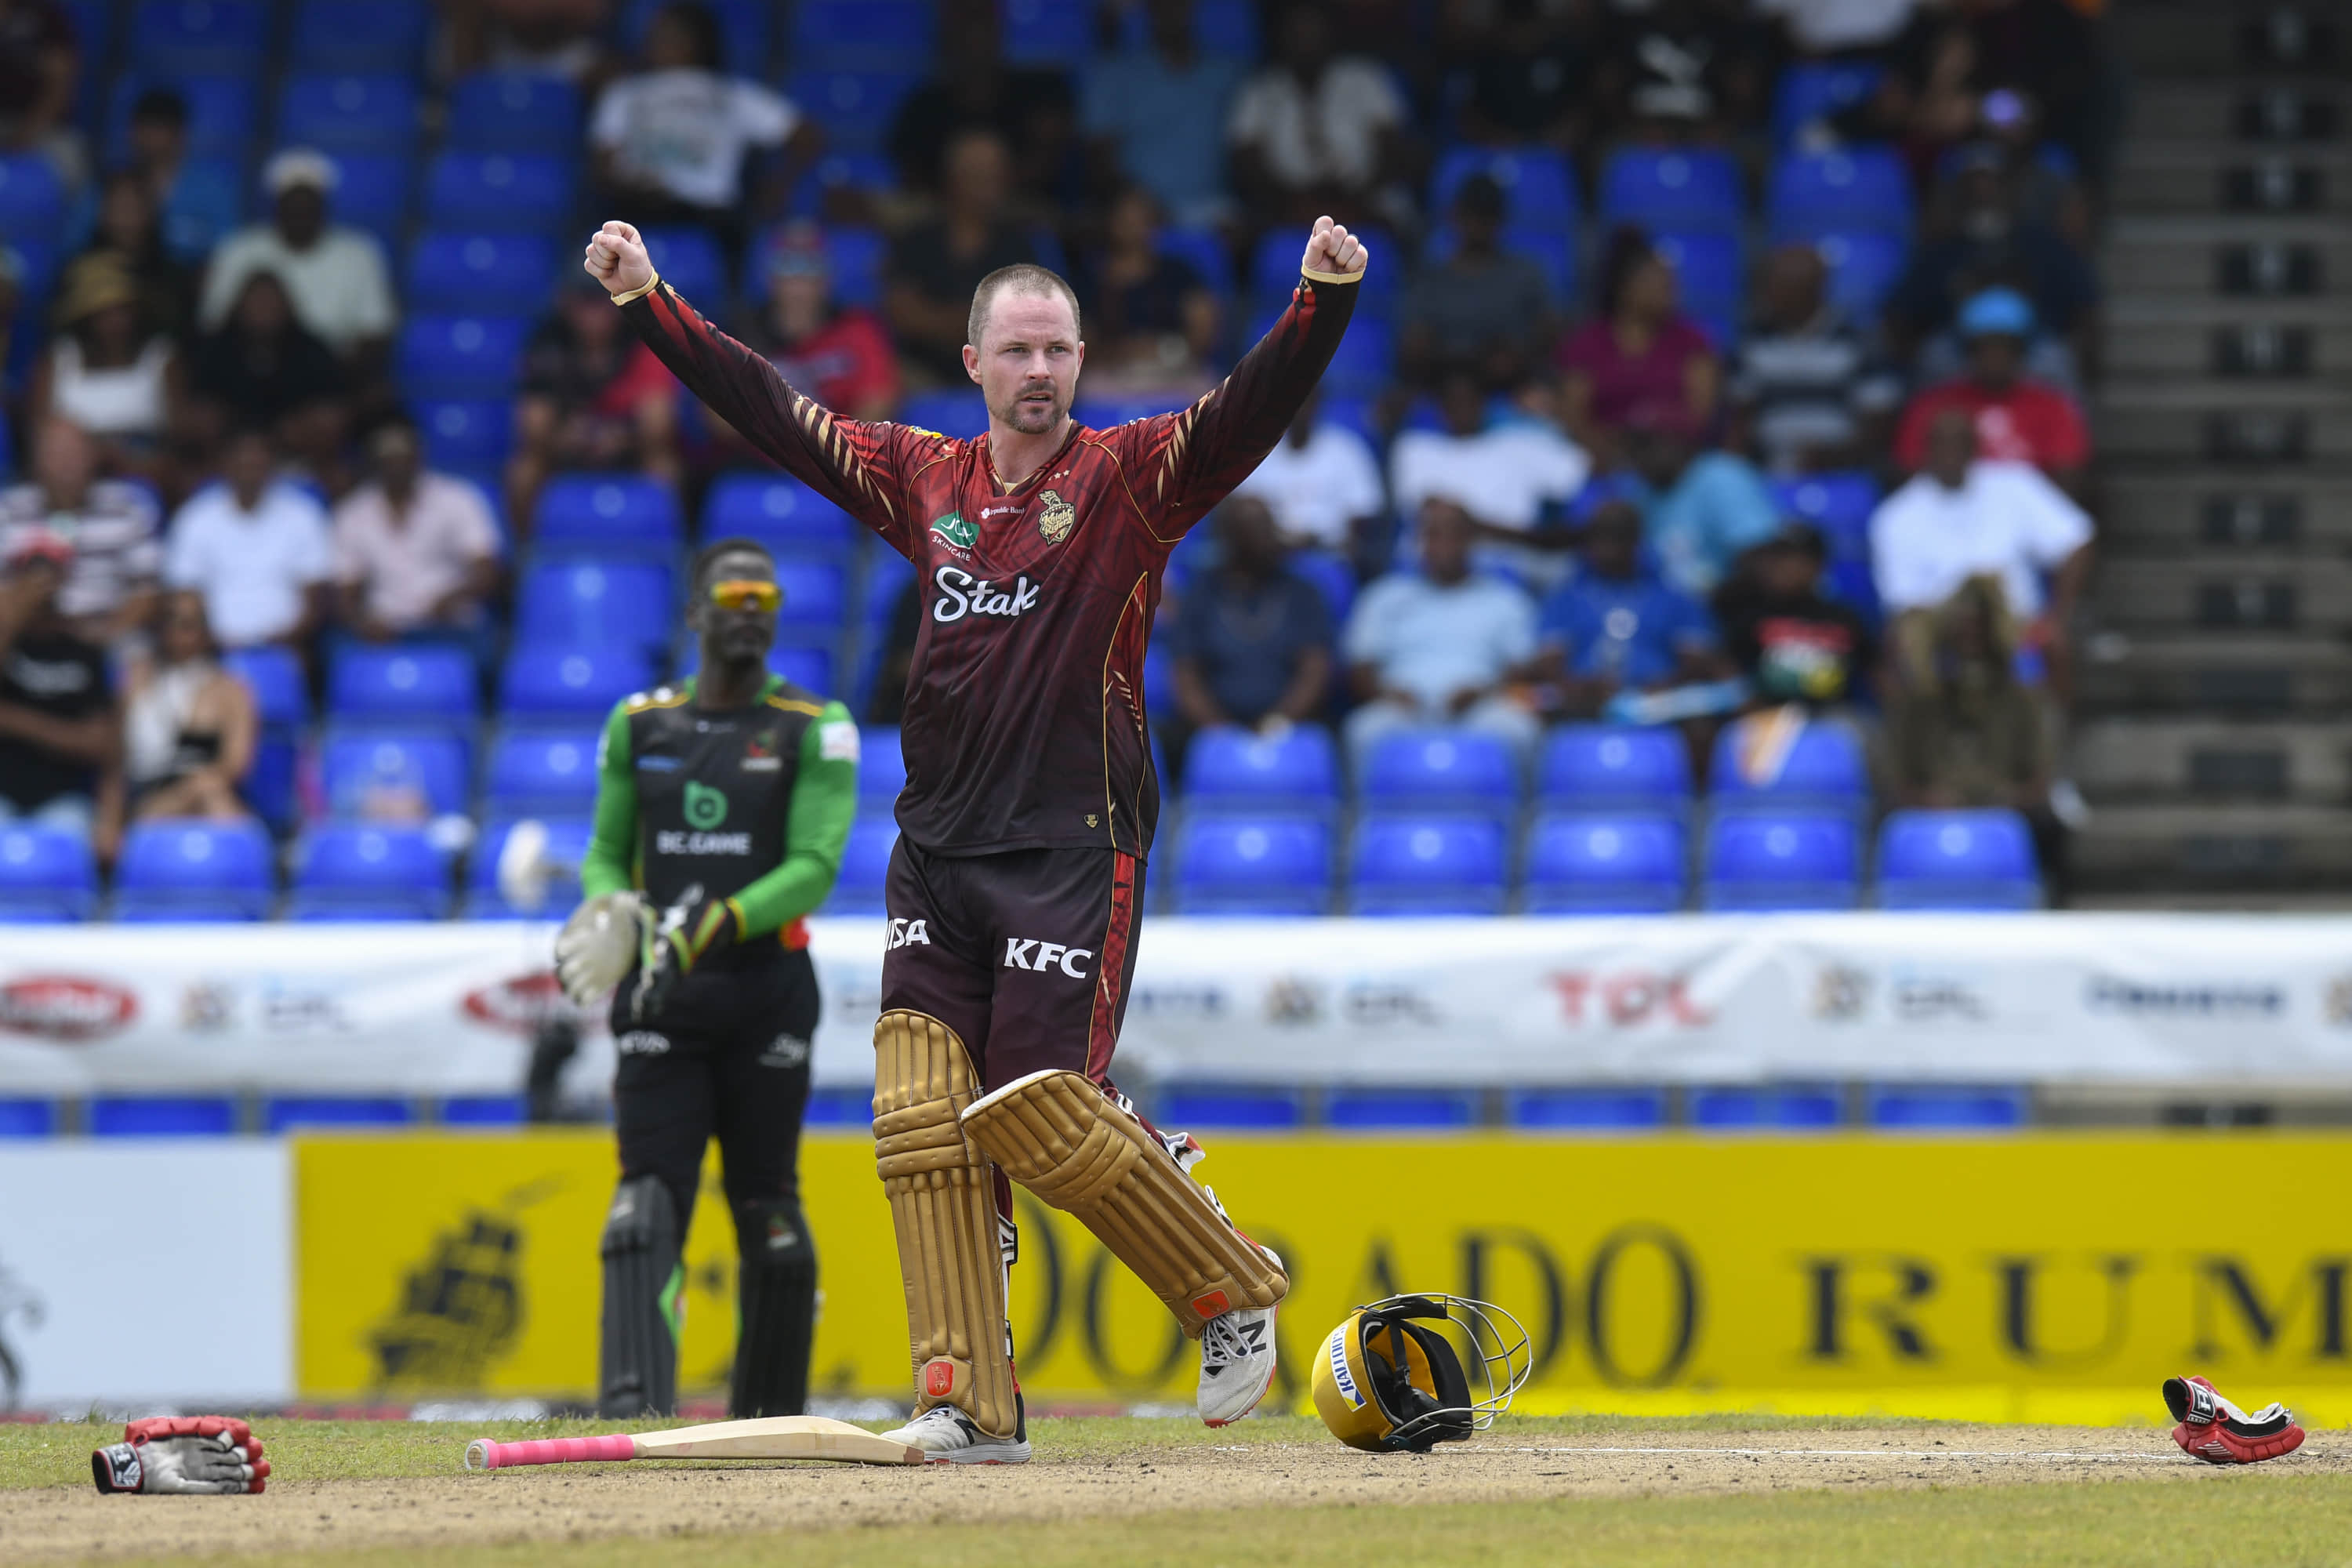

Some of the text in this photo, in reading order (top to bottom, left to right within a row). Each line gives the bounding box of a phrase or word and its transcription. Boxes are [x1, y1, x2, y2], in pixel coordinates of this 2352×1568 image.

[932, 535, 971, 561] SKINCARE
[934, 566, 1040, 622] Stak
[885, 917, 931, 951] ISA
[1004, 938, 1092, 978] KFC
[1780, 1253, 2352, 1369] RUM
